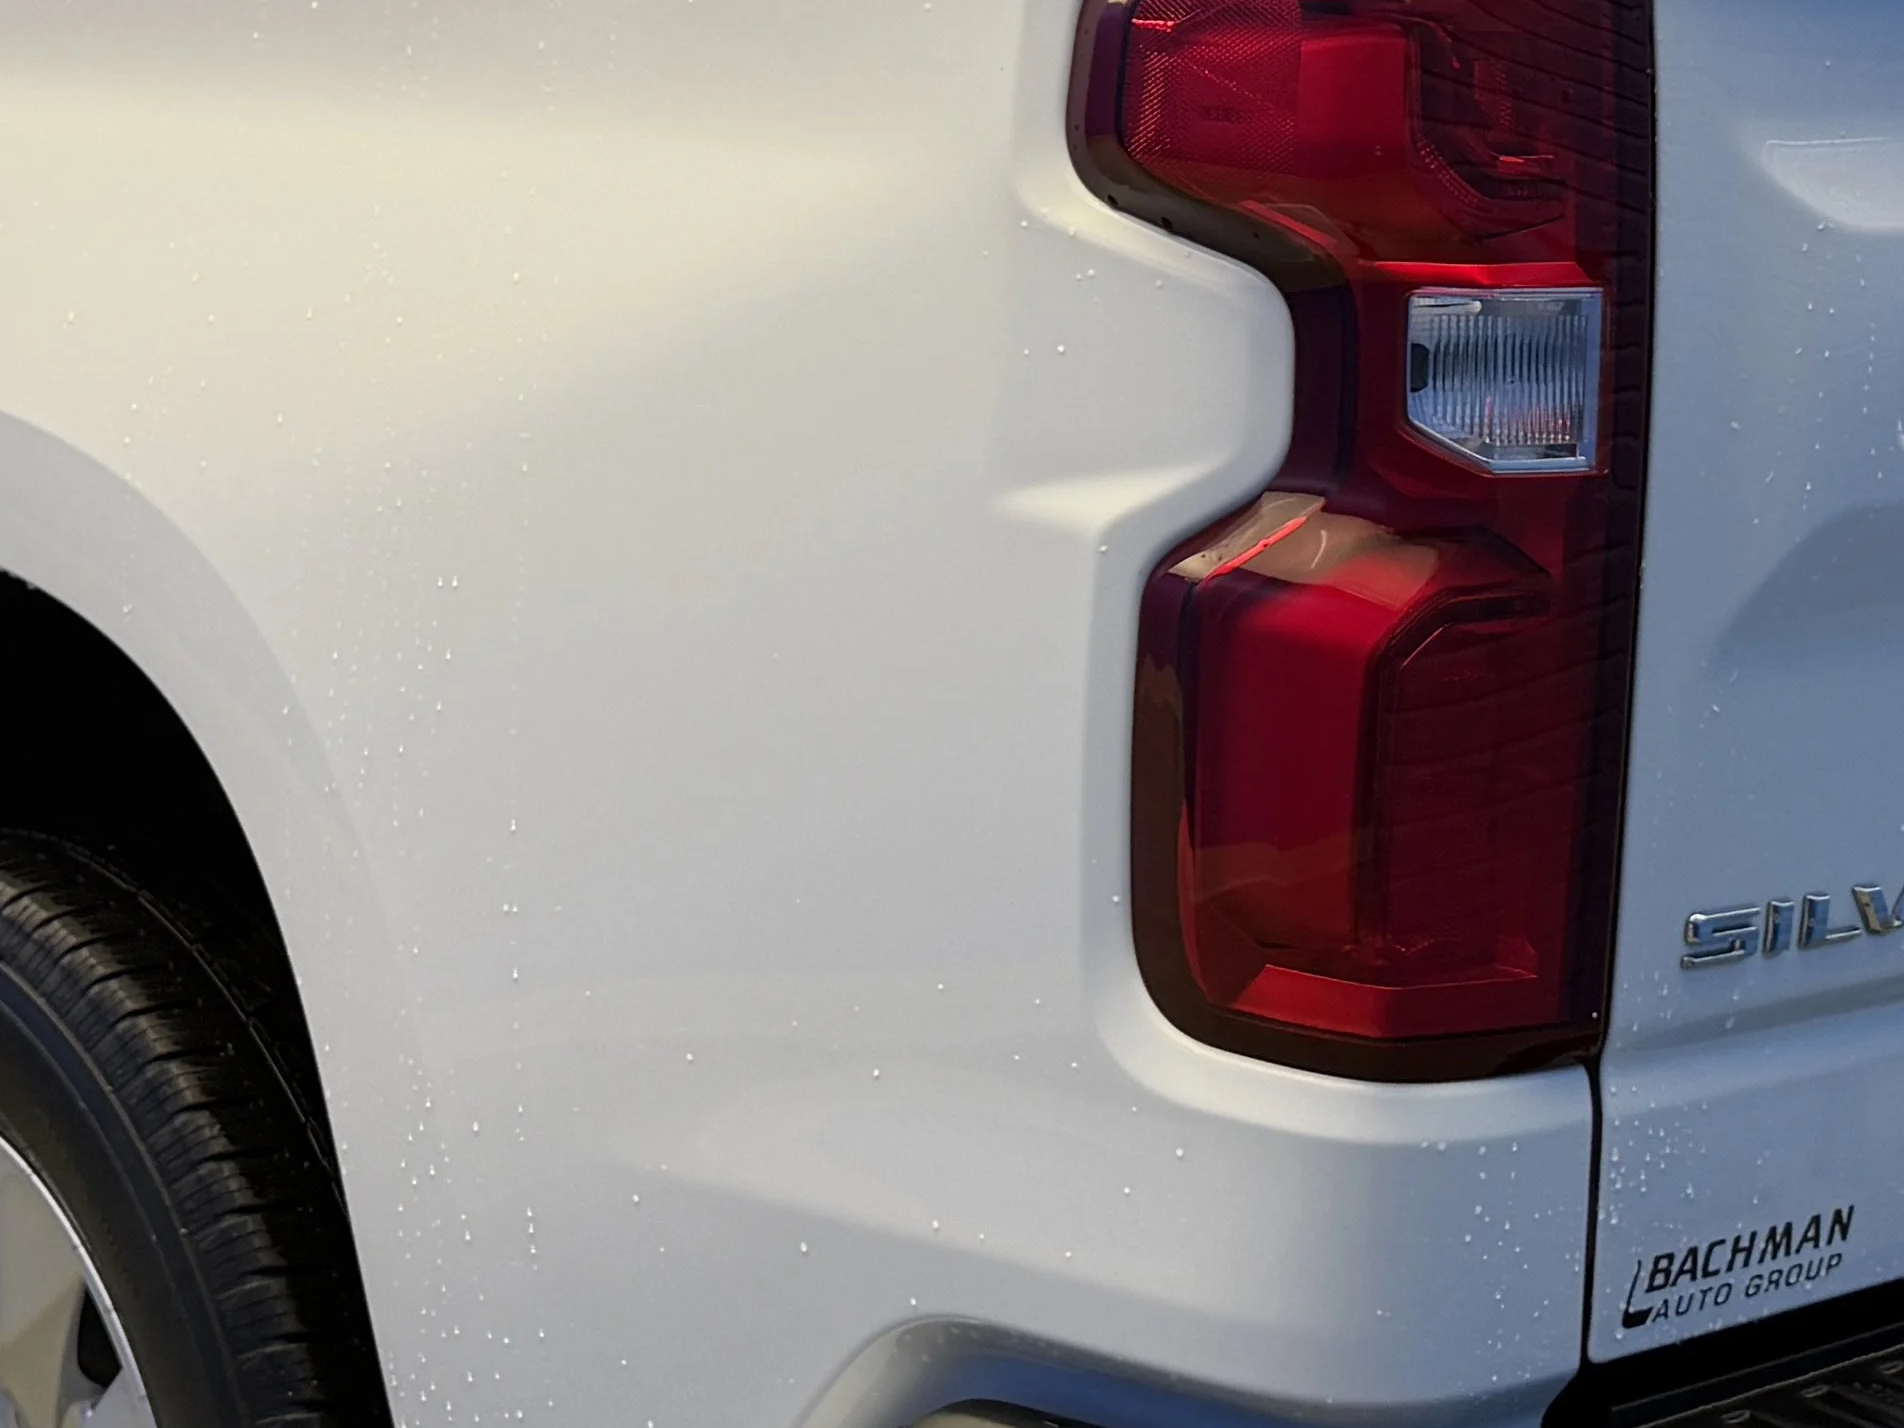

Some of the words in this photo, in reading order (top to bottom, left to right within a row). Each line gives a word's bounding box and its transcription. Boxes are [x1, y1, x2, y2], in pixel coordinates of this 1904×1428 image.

[1644, 1204, 1856, 1294] BACHMAN
[1651, 1282, 1734, 1324] AUTO
[1744, 1252, 1844, 1299] GROUP
